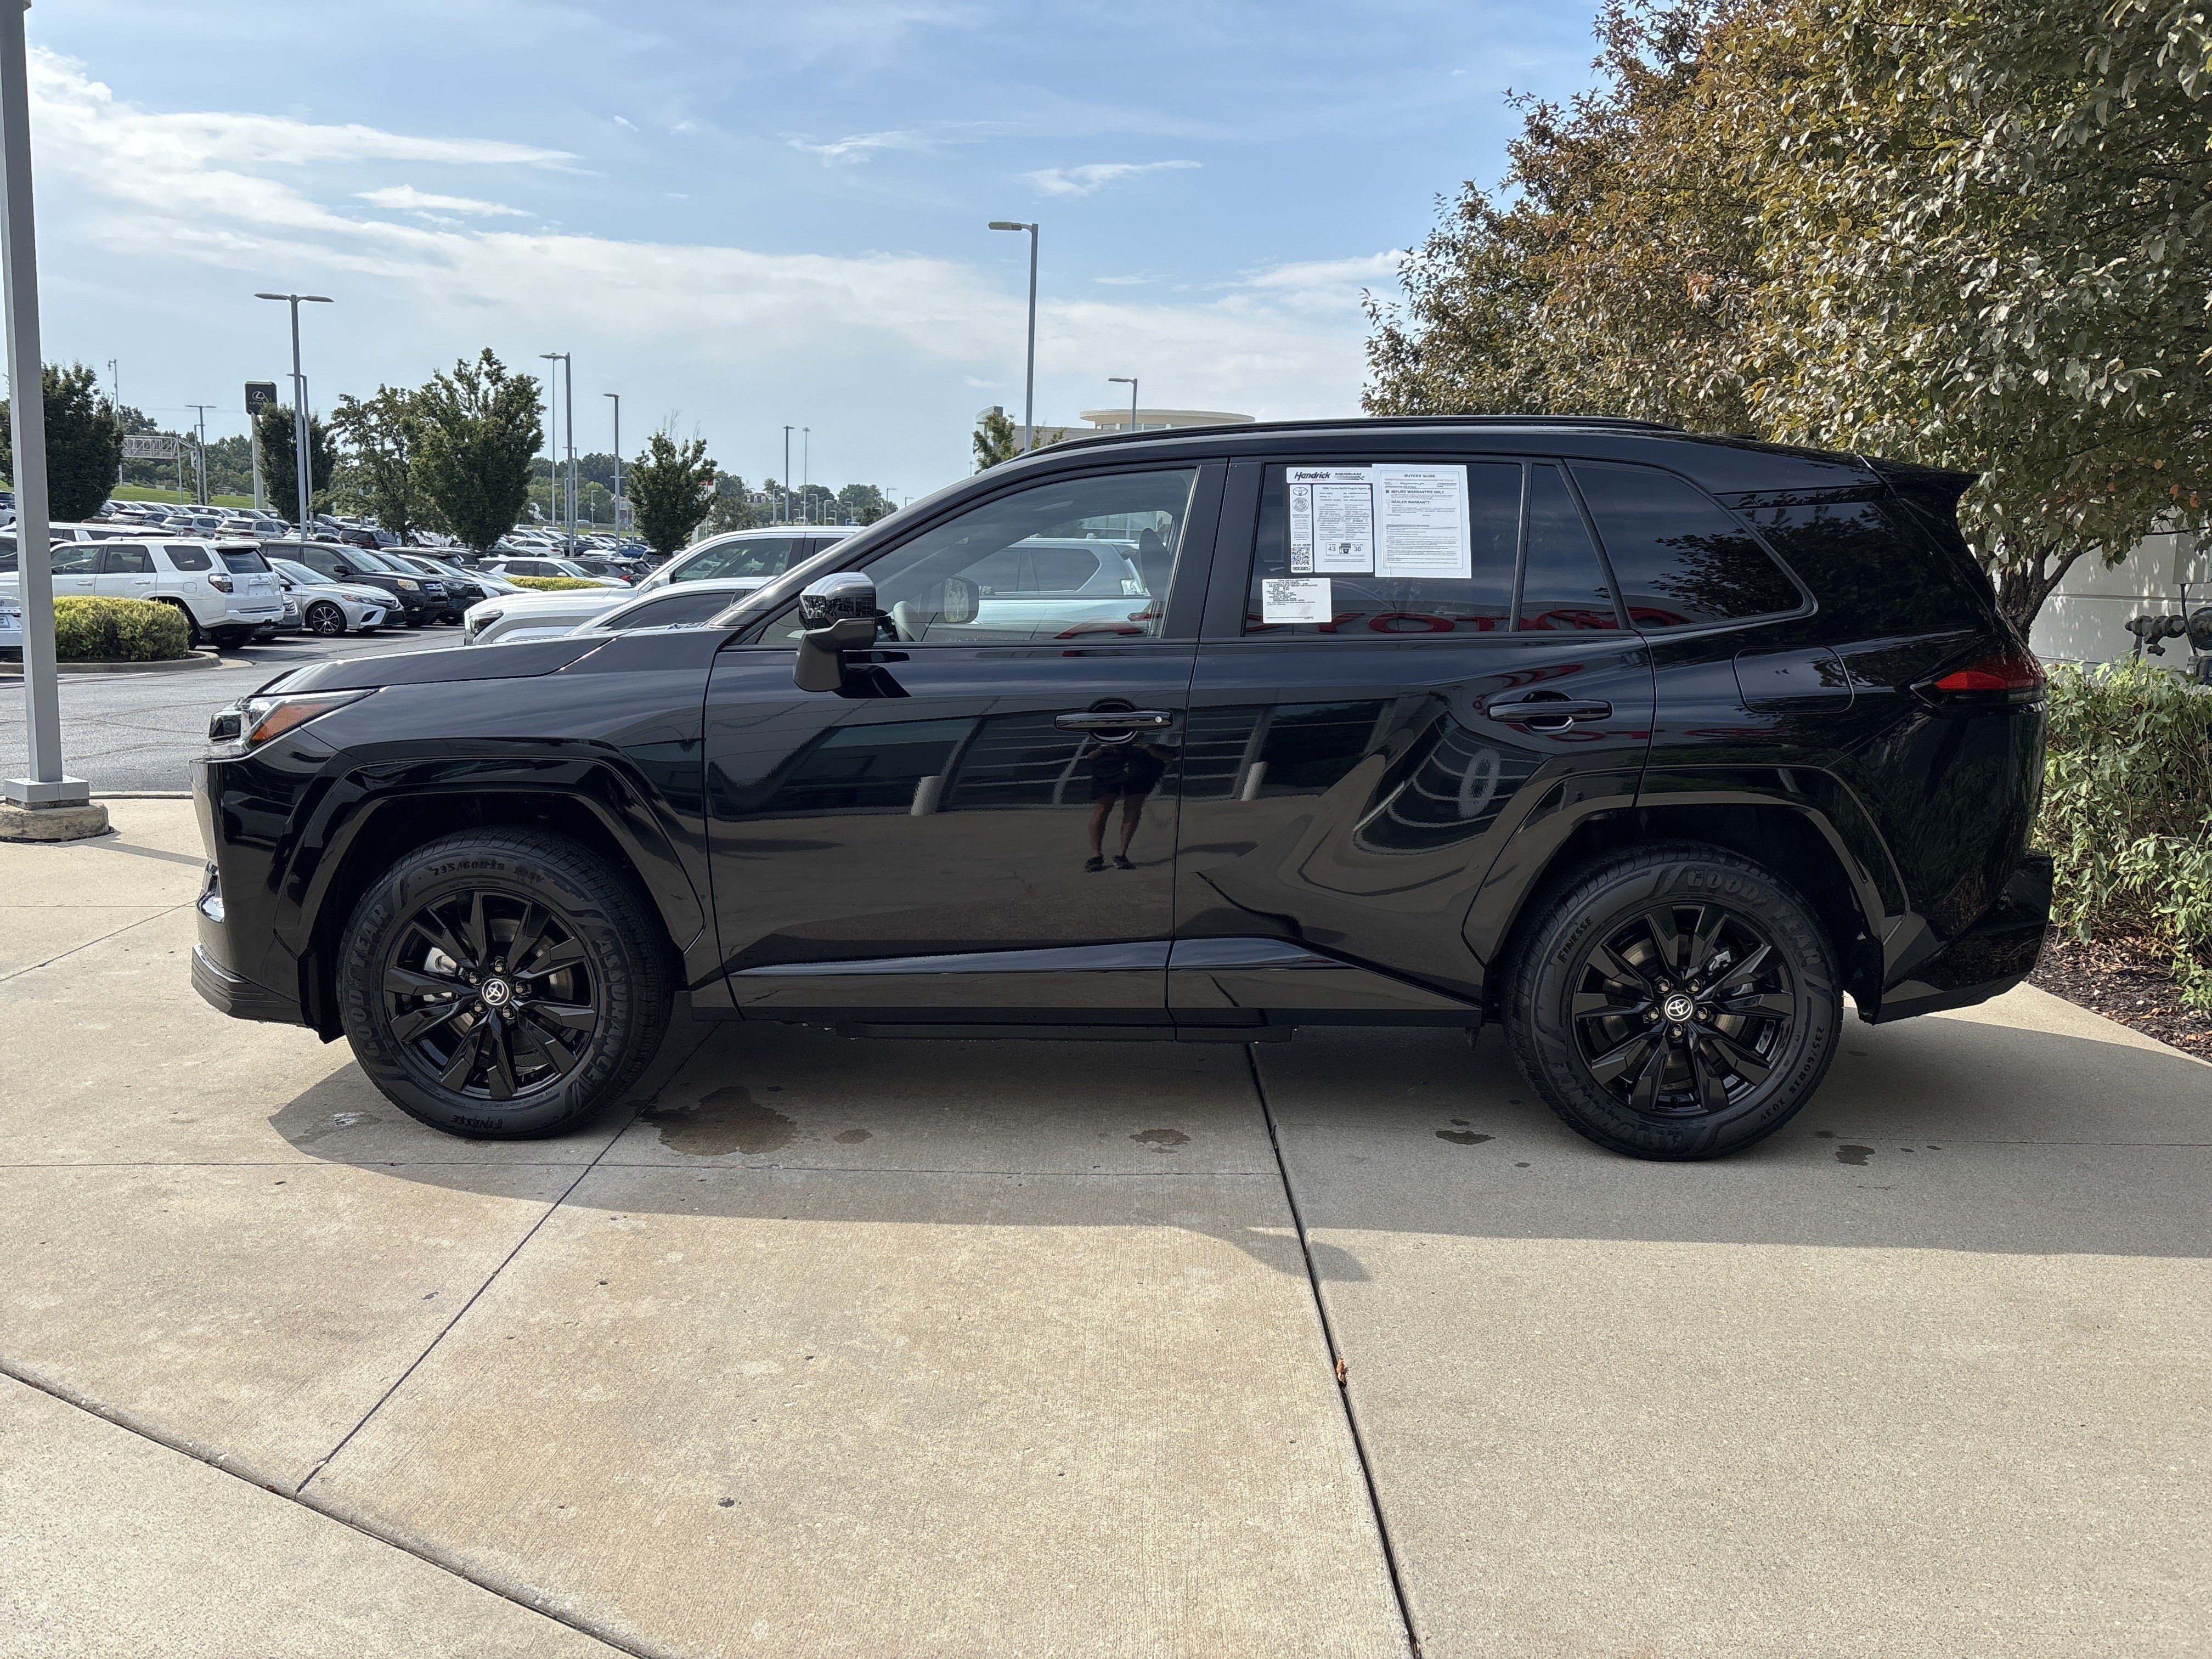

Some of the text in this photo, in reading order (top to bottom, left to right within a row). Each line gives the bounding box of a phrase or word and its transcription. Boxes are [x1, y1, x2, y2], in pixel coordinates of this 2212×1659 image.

[1294, 471, 1331, 481] Hendrick
[1557, 916, 1593, 963] FINESSE
[586, 935, 628, 1085] ASSURANCE
[1788, 1025, 1825, 1094] 235/60R18
[1759, 1097, 1786, 1122] 103V
